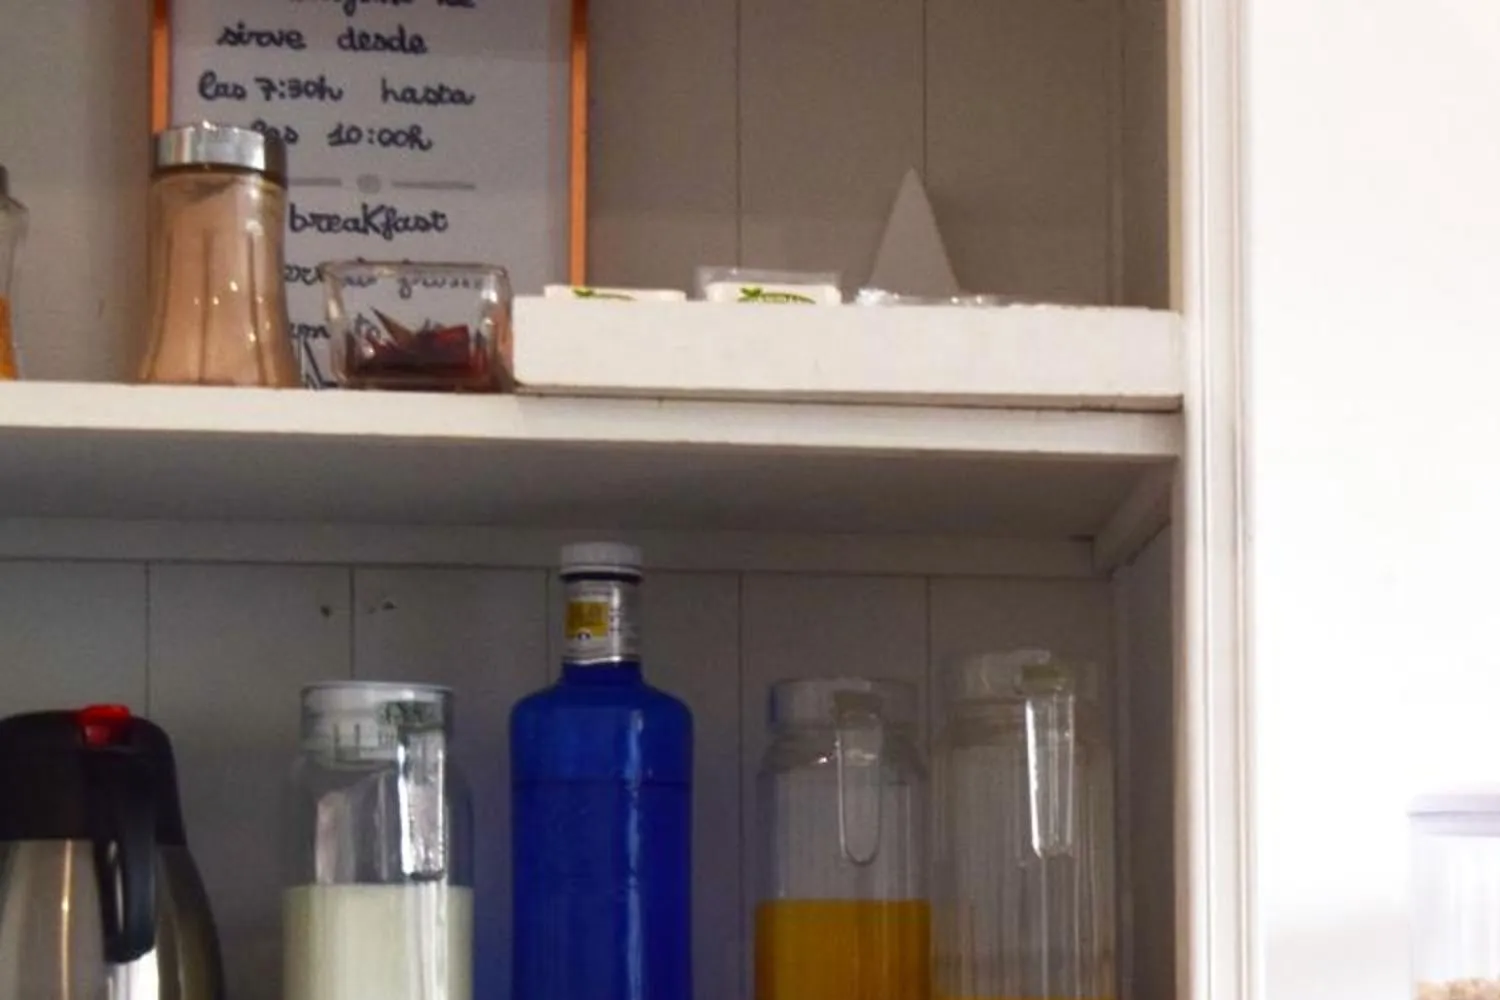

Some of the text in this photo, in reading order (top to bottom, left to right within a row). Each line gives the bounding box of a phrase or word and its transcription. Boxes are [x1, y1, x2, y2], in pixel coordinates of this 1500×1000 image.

[336, 25, 428, 54] desde
[198, 70, 248, 101] las
[381, 76, 475, 106] hasta
